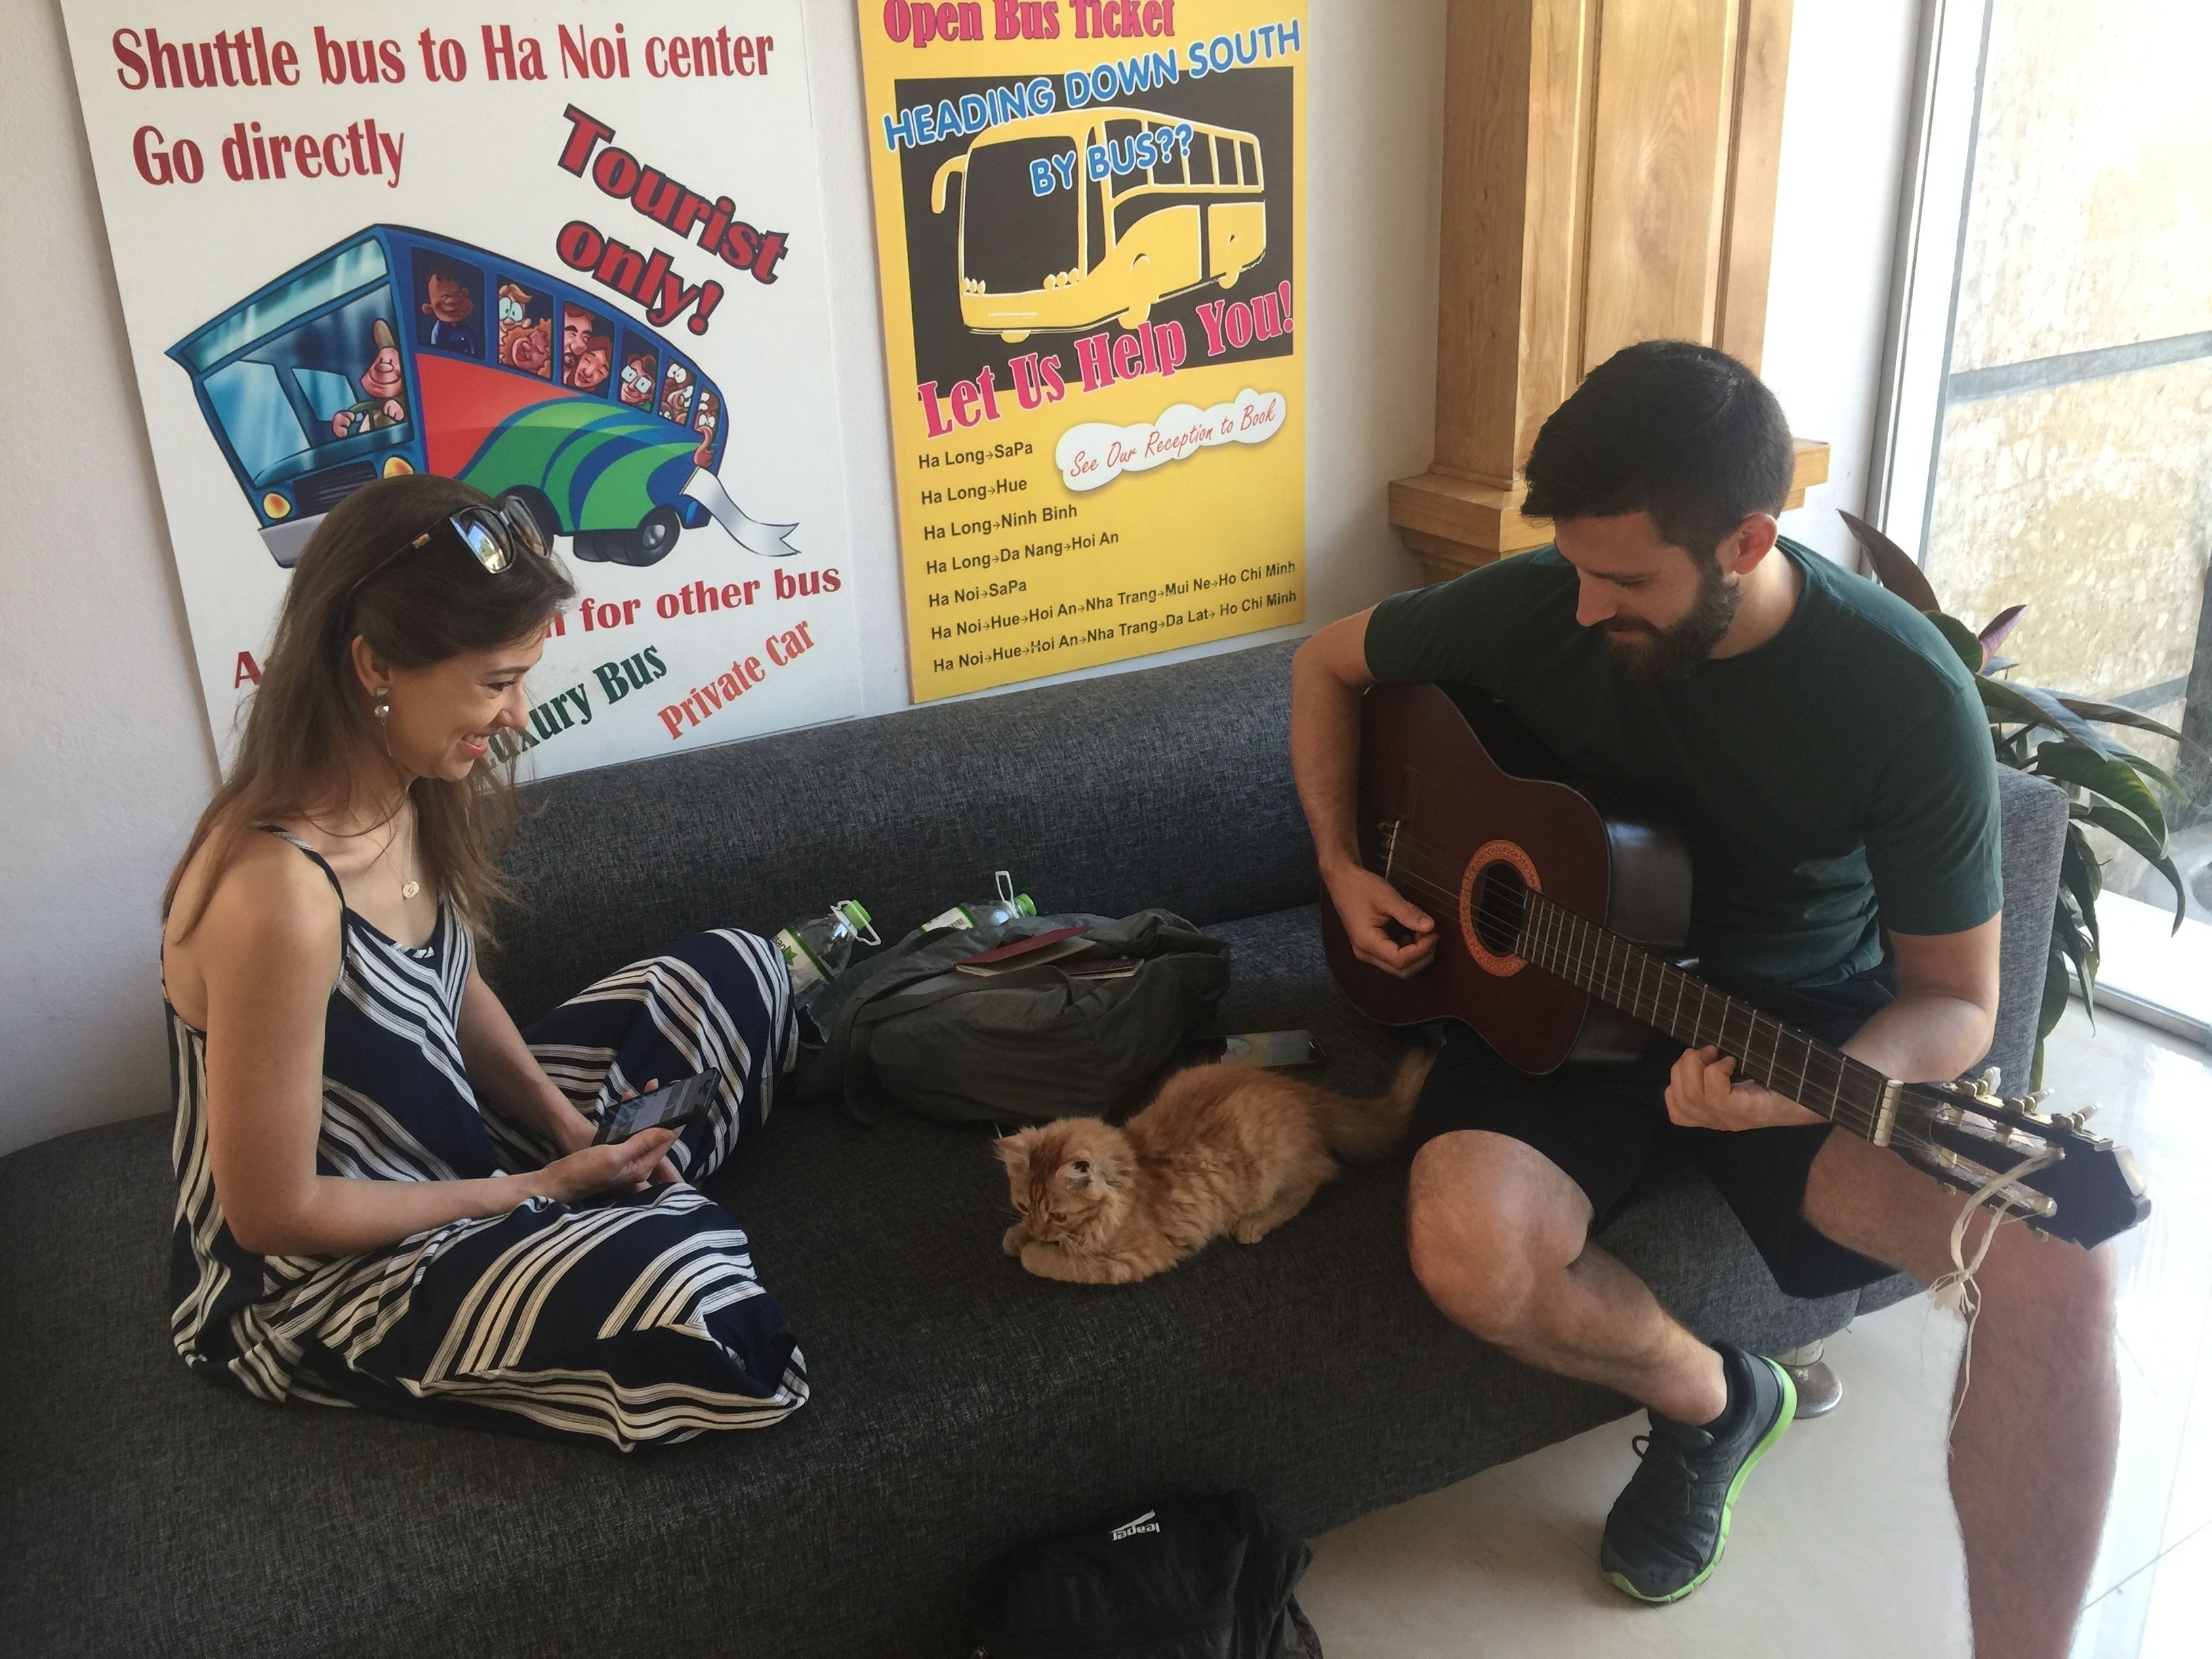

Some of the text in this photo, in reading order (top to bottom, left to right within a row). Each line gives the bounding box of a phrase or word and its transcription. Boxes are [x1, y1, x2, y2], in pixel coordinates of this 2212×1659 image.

[112, 23, 773, 89] Shuttle bus to Ha Noi center
[884, 0, 1175, 47] Open Bus Ticket
[882, 19, 1300, 150] HEADING DOWN SOUTH
[133, 119, 404, 188] Go directly
[1030, 123, 1193, 197] BY BUS??
[557, 102, 789, 285] Tourist
[556, 220, 724, 335] only!
[918, 280, 1294, 438] Let Us Help You!
[919, 454, 940, 469] Ha
[1070, 398, 1276, 476] See Our Reception to Book
[922, 490, 942, 505] Ha
[924, 525, 945, 540] Ha
[1042, 504, 1077, 522] Binh
[926, 560, 947, 575] Ha
[1099, 532, 1118, 546] An
[579, 598, 641, 632] for
[656, 578, 760, 619] other
[774, 567, 841, 601] bus
[929, 594, 949, 607] Ha
[931, 627, 951, 640] Ha
[1240, 567, 1261, 582] Chi
[1266, 561, 1296, 577] Minh
[934, 659, 954, 673] Ha
[1220, 602, 1237, 616] Ho
[1242, 596, 1263, 611] Chi
[1267, 590, 1296, 607] Minh
[489, 644, 667, 763] uxury Bus
[657, 619, 815, 740] Private Car
[1112, 1521, 1160, 1541] leaper
